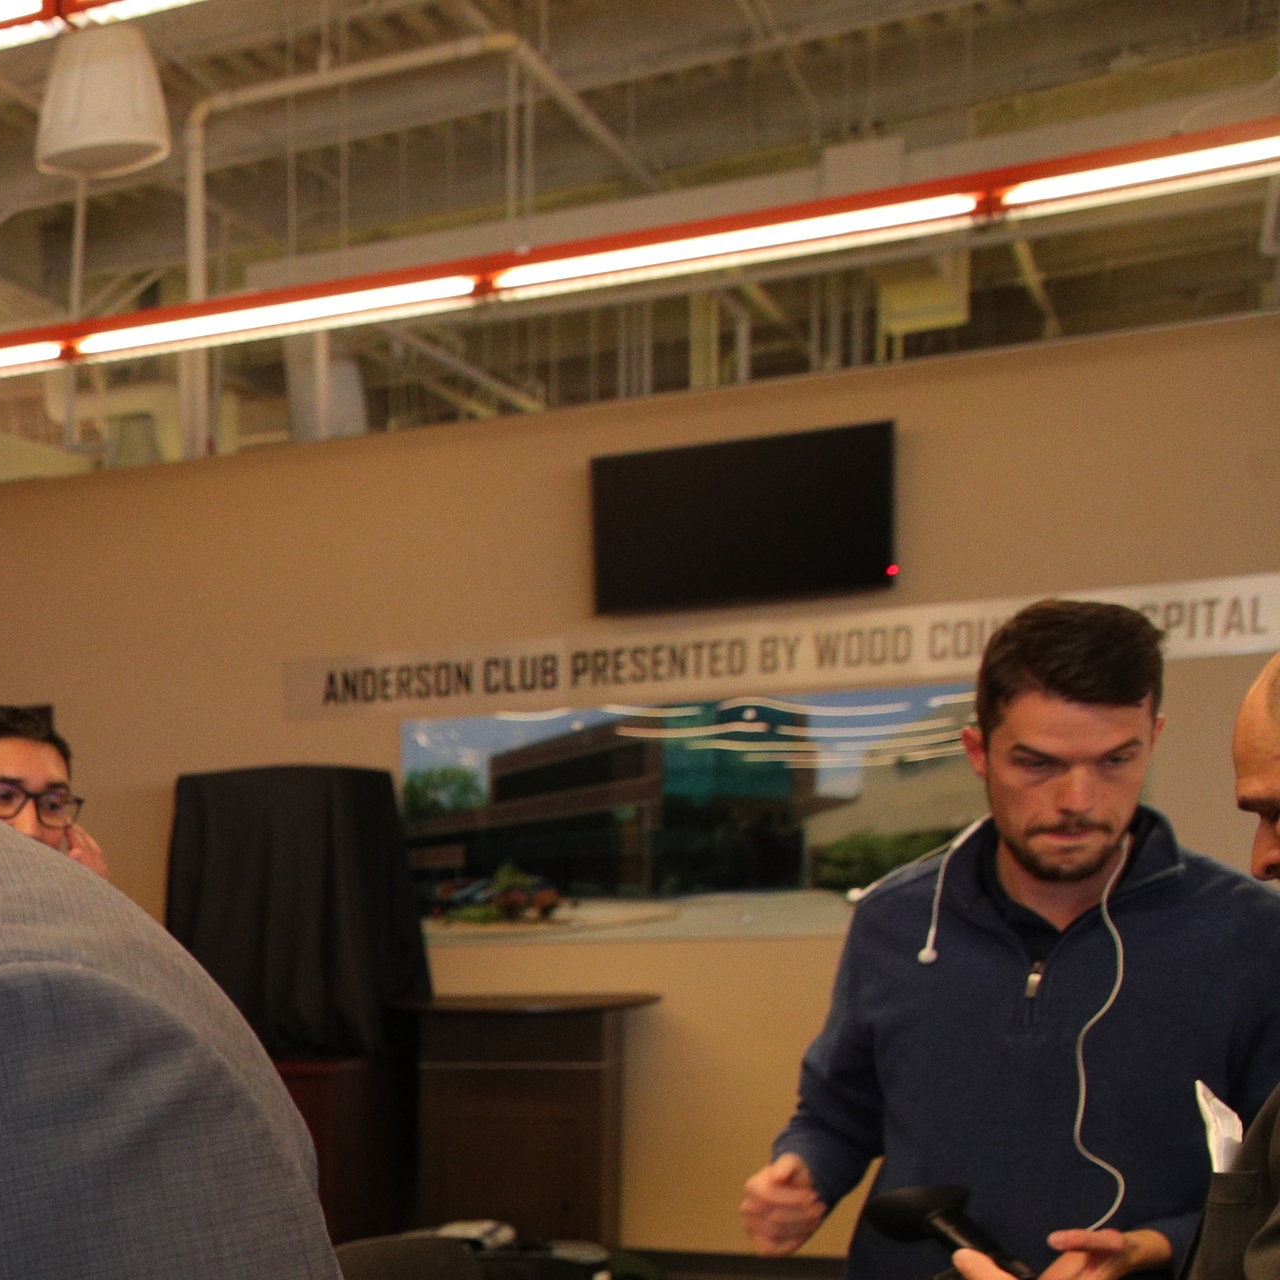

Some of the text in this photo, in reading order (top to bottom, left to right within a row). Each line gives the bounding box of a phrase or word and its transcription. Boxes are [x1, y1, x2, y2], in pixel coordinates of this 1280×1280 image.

[322, 661, 473, 704] ANDERSON
[484, 654, 559, 695] CLUB
[569, 637, 744, 688] PRESENTED
[759, 633, 800, 673] BY
[813, 624, 912, 668] WOOD
[1141, 594, 1268, 641] PITAL
